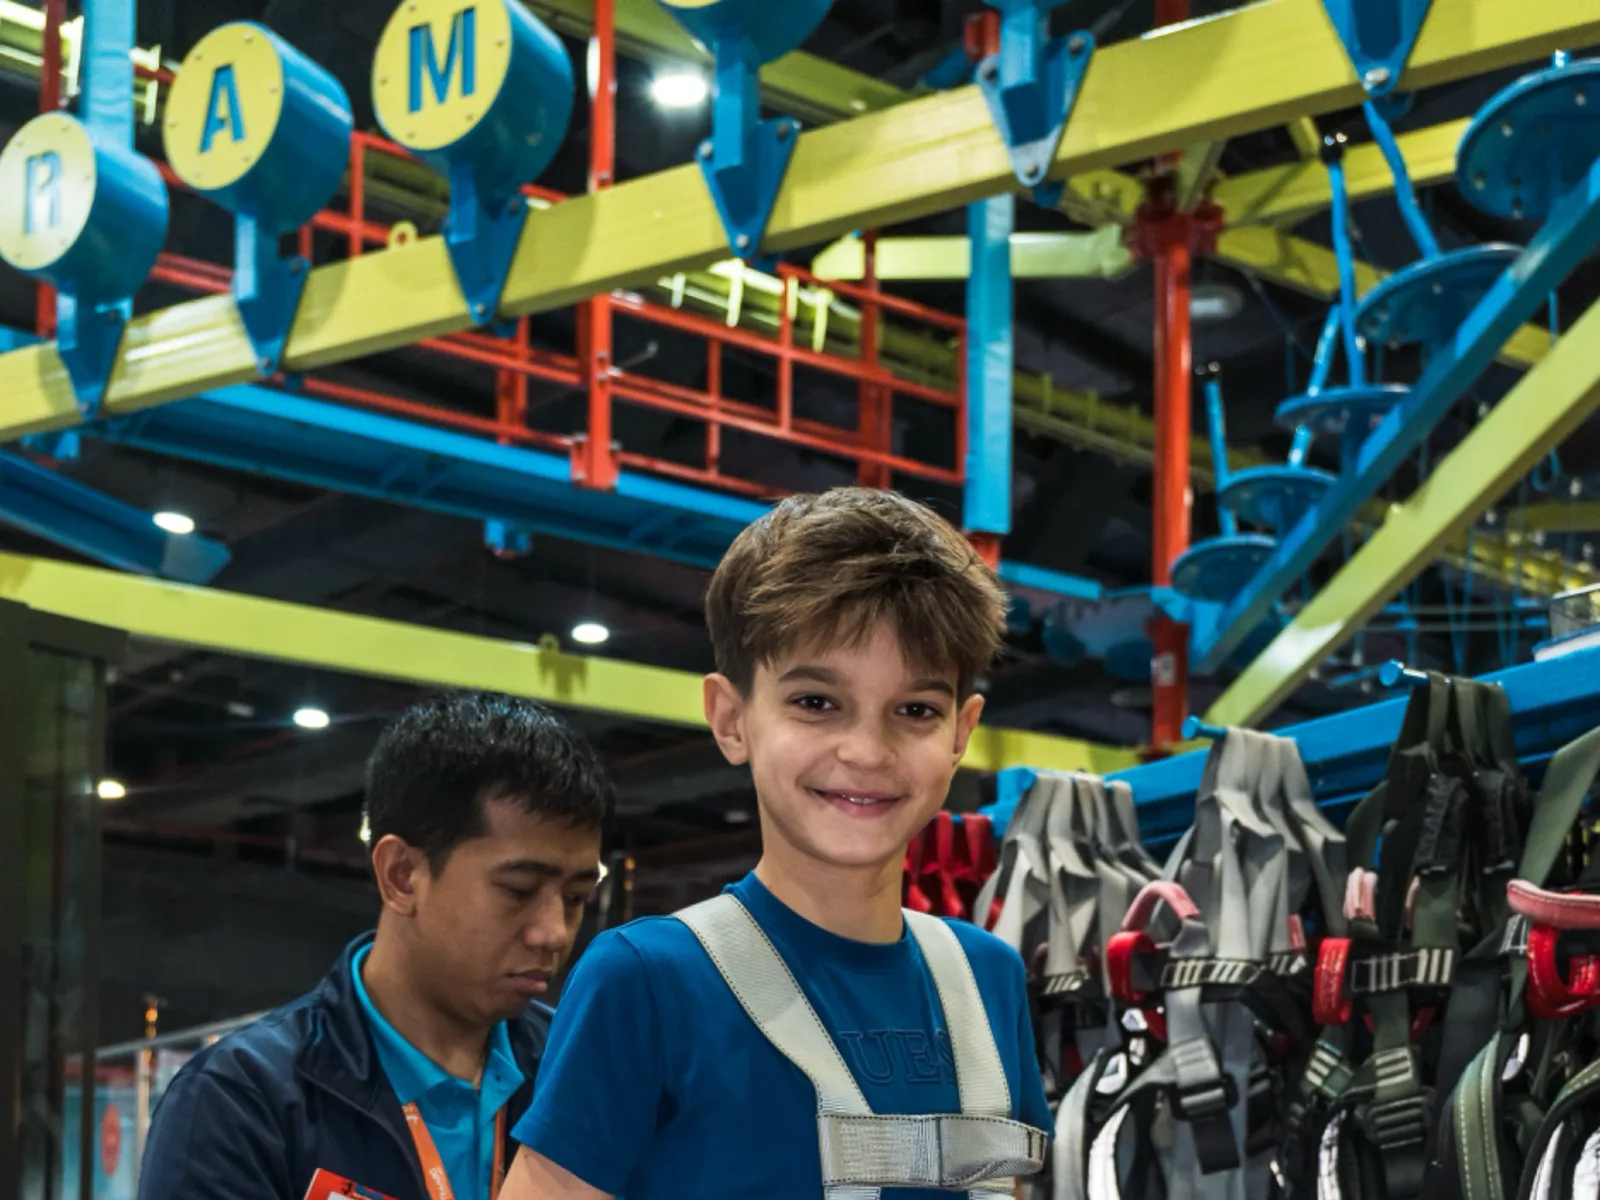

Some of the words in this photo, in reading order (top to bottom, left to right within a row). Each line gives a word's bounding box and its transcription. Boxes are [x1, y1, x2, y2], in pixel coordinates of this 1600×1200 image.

[25, 151, 63, 236] R
[200, 64, 246, 154] A
[408, 8, 477, 114] M
